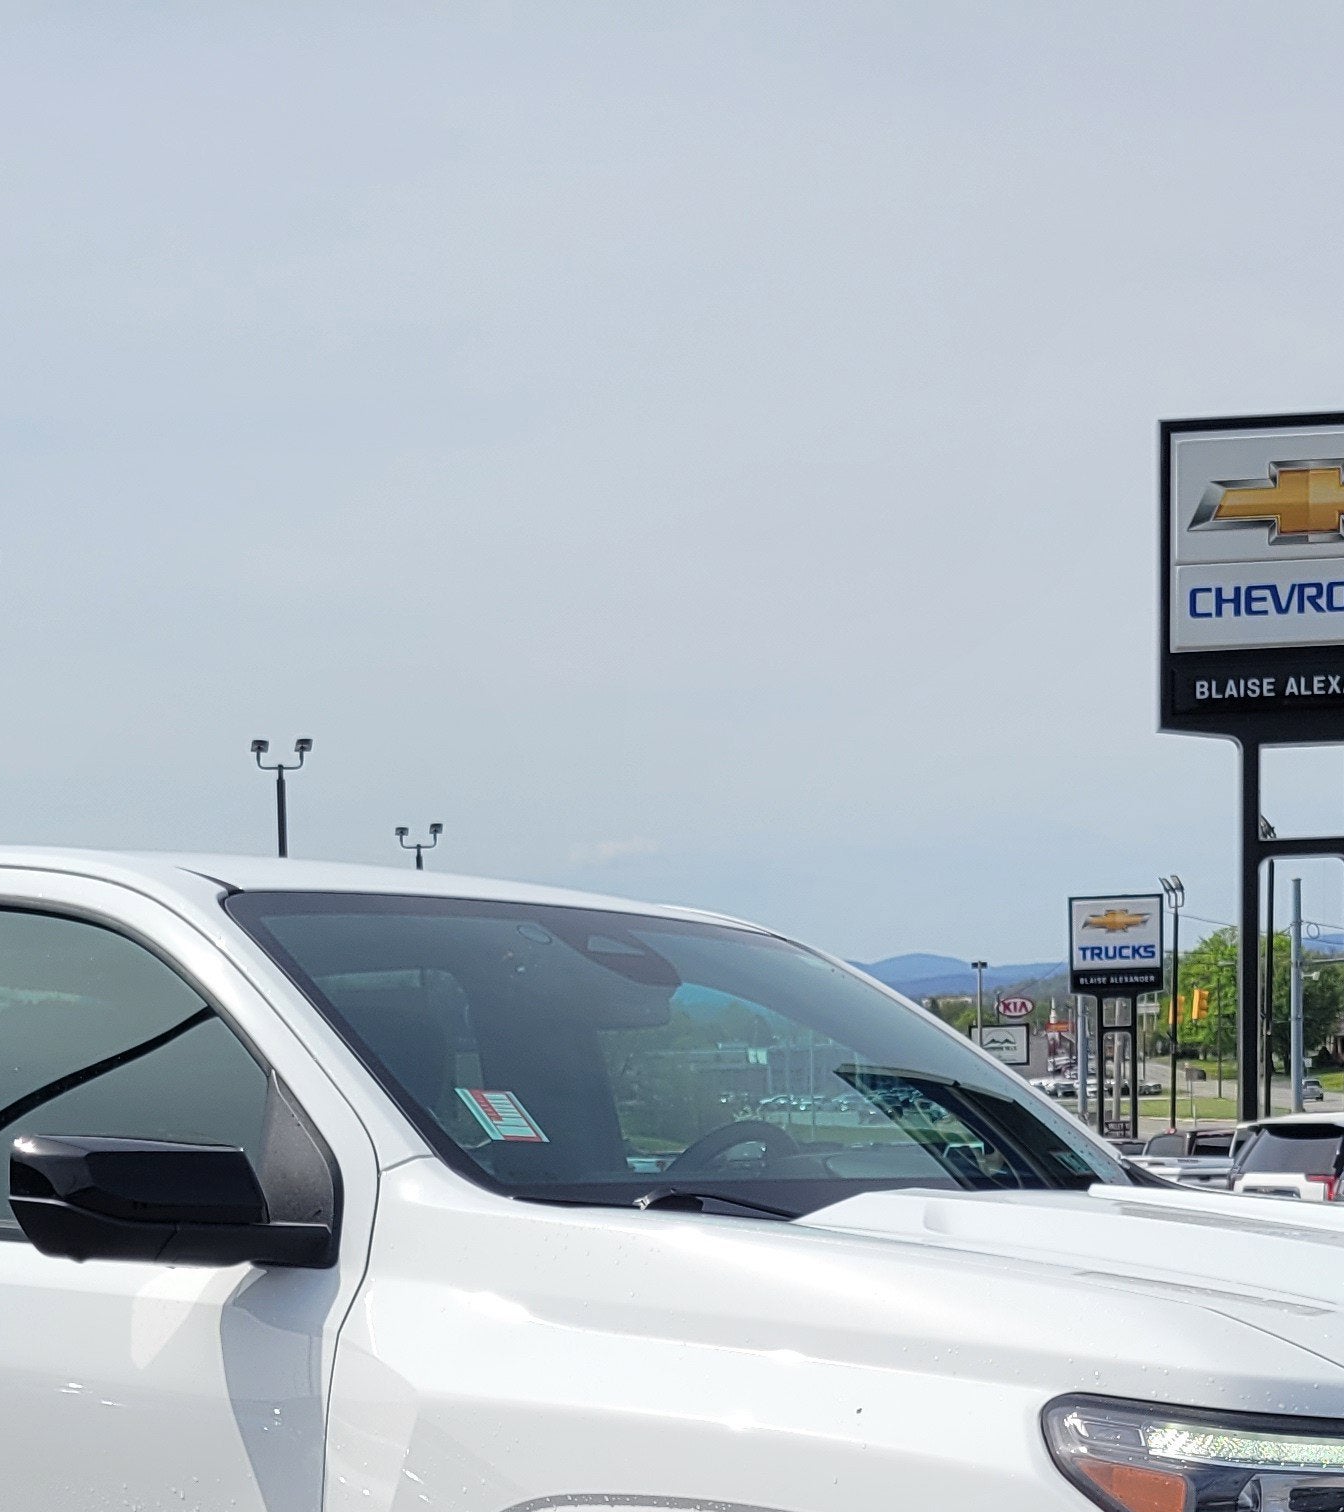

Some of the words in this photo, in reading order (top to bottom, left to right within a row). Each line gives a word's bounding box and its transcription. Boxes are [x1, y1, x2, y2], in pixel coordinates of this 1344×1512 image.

[1195, 677, 1276, 700] BLAISE
[1078, 944, 1156, 961] TRUCKS
[1079, 976, 1107, 985] BLAISE
[1109, 974, 1156, 984] ALEXANDER
[1001, 1001, 1029, 1014] KIA
